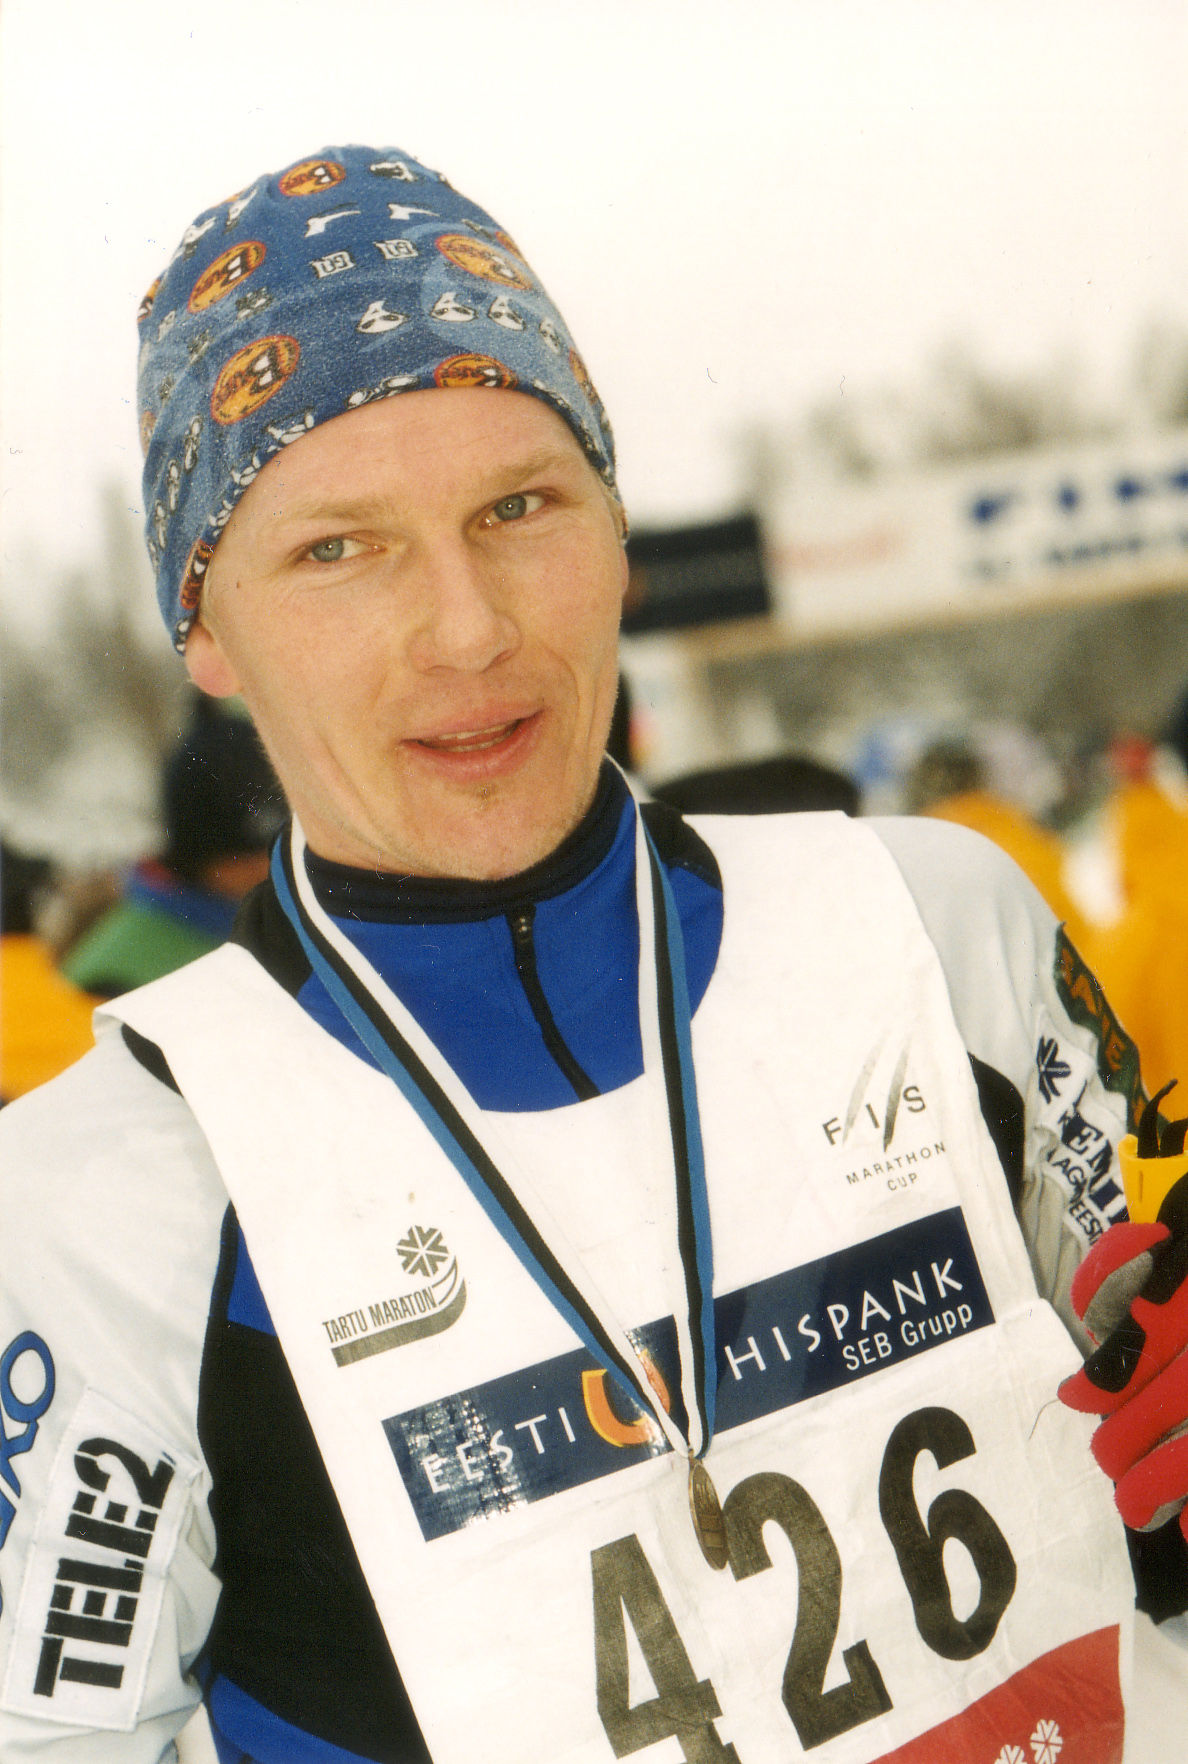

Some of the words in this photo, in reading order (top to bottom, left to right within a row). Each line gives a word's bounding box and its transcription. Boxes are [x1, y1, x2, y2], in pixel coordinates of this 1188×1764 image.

[822, 1085, 926, 1145] FIS
[846, 1141, 946, 1185] MARATHON
[887, 1172, 917, 1191] CUP
[322, 1309, 369, 1343] TARTU
[368, 1286, 437, 1327] MARATON
[842, 1332, 893, 1371] SEB
[900, 1303, 973, 1347] Grupp
[421, 1407, 576, 1494] EESTI
[33, 1437, 176, 1698] TELE2
[591, 1406, 1017, 1764] 426
